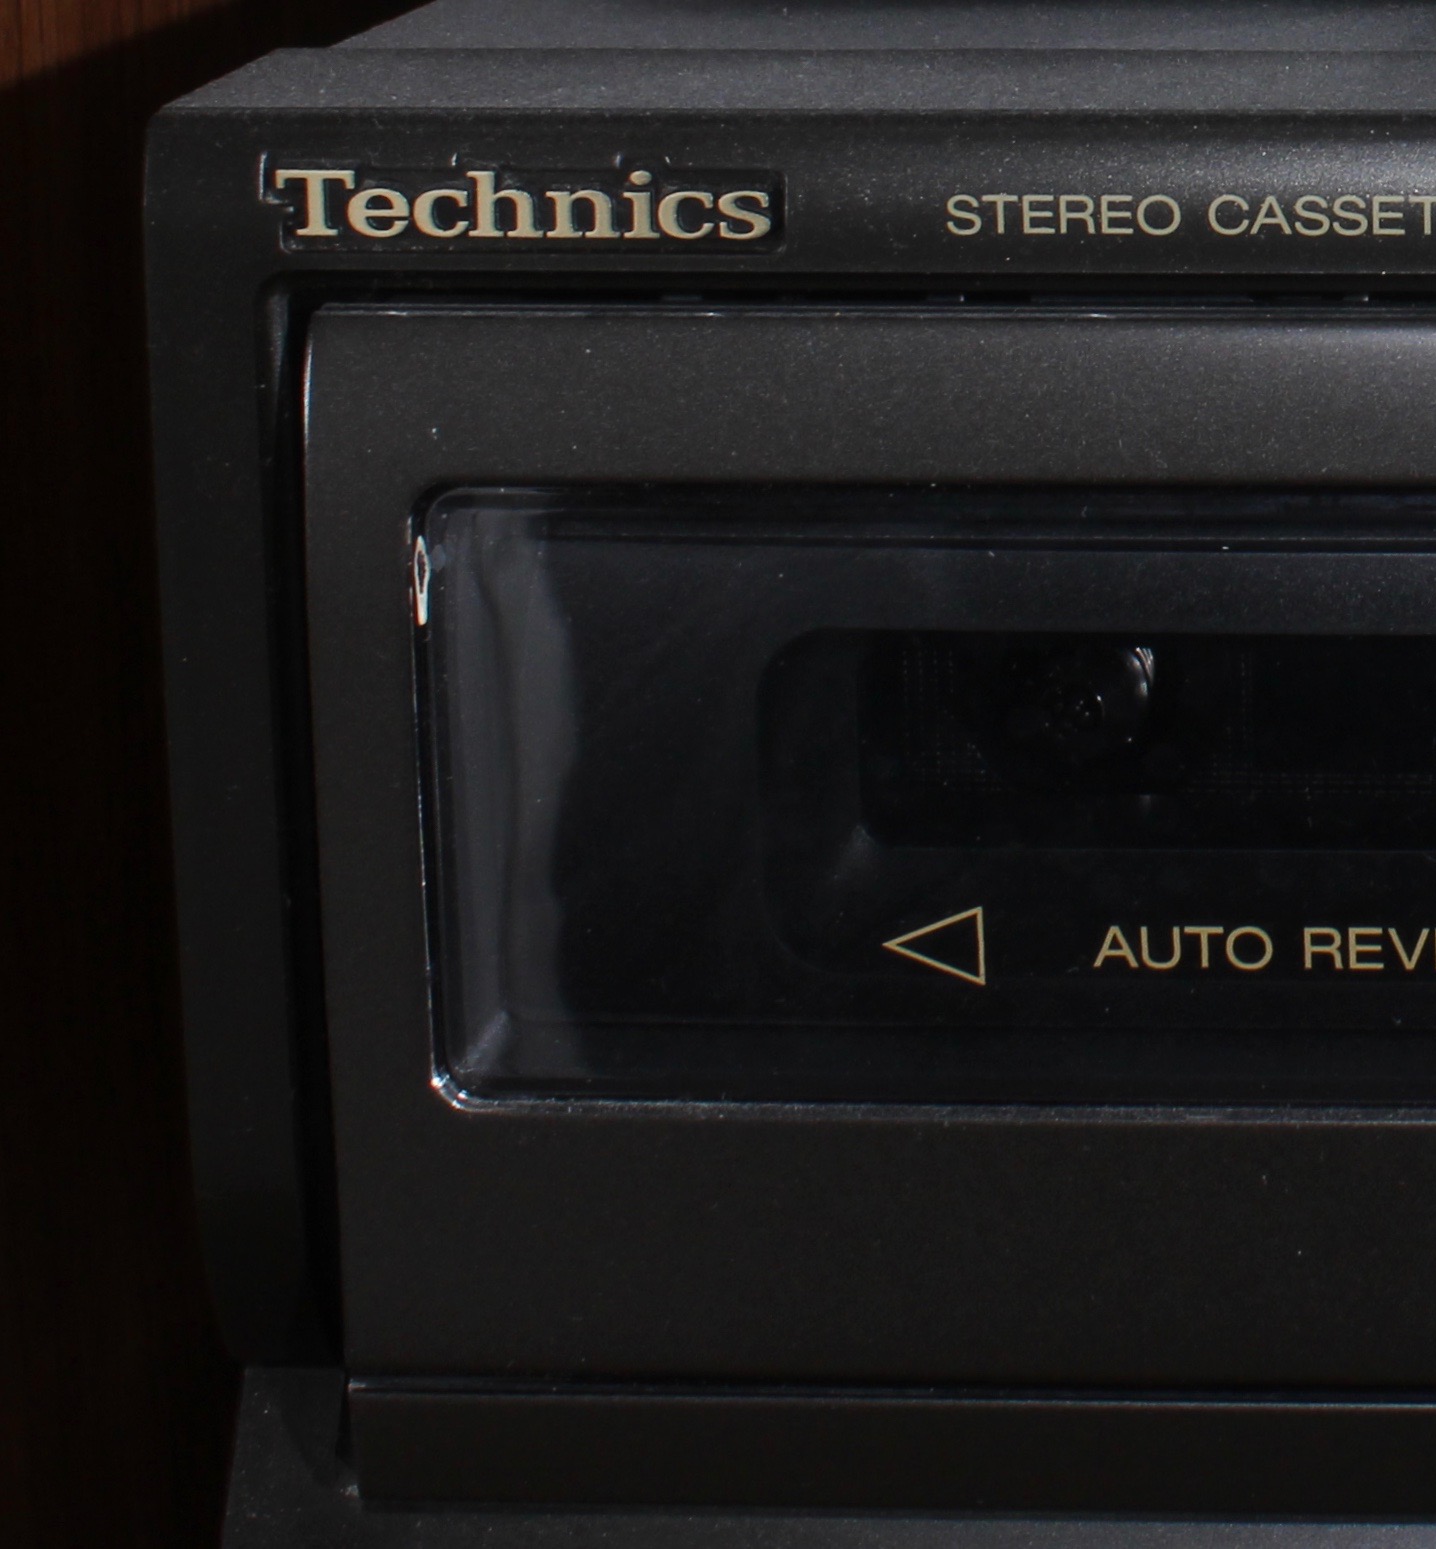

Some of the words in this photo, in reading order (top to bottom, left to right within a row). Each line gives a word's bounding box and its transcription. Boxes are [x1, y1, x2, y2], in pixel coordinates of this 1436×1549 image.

[275, 168, 772, 240] Technics
[946, 192, 1181, 236] STEREO
[1093, 925, 1274, 971] AUTO
